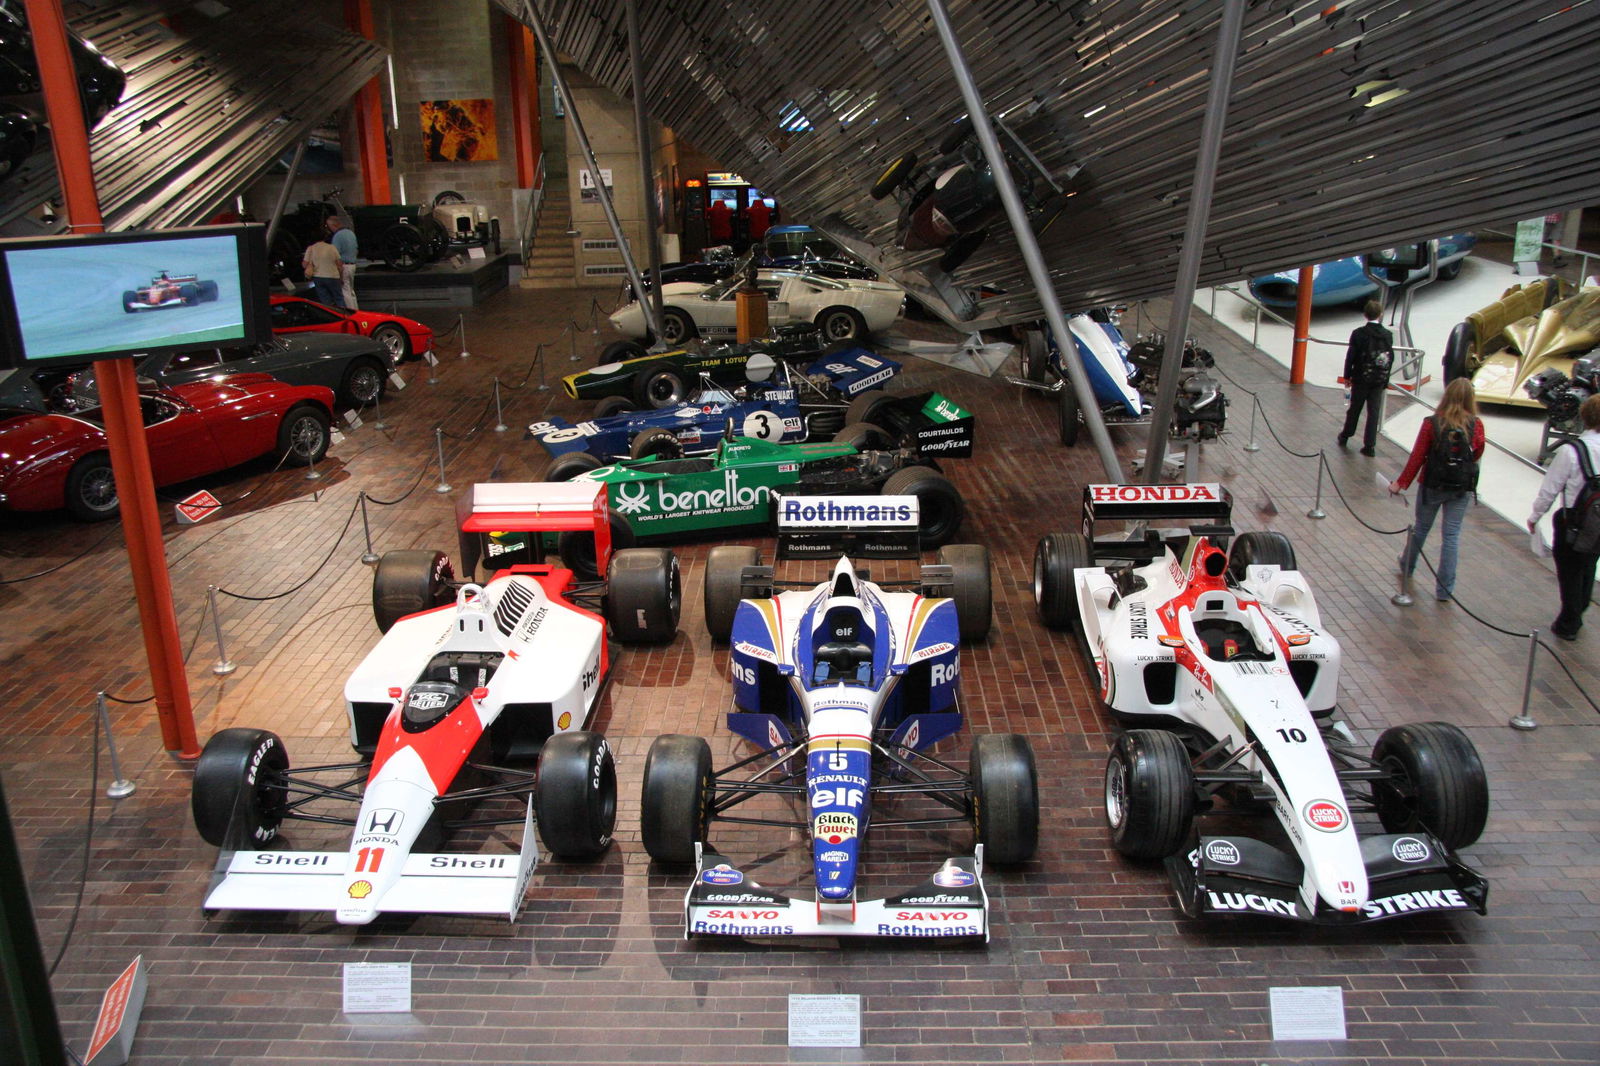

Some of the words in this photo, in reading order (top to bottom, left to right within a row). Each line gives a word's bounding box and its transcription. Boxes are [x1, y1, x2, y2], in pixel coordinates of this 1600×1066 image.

[701, 359, 721, 367] TEAM
[725, 355, 748, 365] LOTUS
[825, 363, 858, 374] elf
[851, 369, 892, 393] GOODYEAR
[764, 389, 795, 401] STEWART
[755, 414, 771, 439] 3
[783, 416, 799, 427] elf
[918, 427, 964, 439] COURTAULDS
[920, 439, 971, 452] GOODYEAR
[1092, 486, 1216, 502] HONDA
[637, 513, 664, 522] WORLD'S
[664, 511, 691, 520] LARGEST
[692, 508, 722, 517] KNITWEAR
[723, 504, 755, 514] PRODUCER
[785, 500, 911, 521] Rothmans
[788, 543, 831, 551] Rothmans
[865, 543, 908, 551] Rothmans
[1168, 557, 1186, 589] HONDA
[1129, 601, 1147, 617] LUCKY
[526, 606, 549, 635] HONDA
[835, 627, 853, 636] elf
[1130, 618, 1149, 640] STRIKE
[813, 698, 870, 710] Rothmans
[1276, 728, 1308, 743] 10
[247, 743, 268, 786] EAGLE
[828, 753, 848, 771] 5
[808, 774, 868, 788] RENAULT
[811, 787, 864, 809] elf
[1311, 808, 1340, 816] LUCKY
[818, 814, 855, 826] Black
[1312, 815, 1342, 823] STRIKE
[816, 824, 856, 836] Tower
[354, 836, 400, 847] HONDA
[1396, 842, 1423, 853] LUCKY
[1210, 845, 1235, 855] LUCKY
[1399, 850, 1426, 860] STRIKE
[255, 853, 329, 867] Shell
[354, 847, 386, 873] 11
[429, 856, 506, 869] Shell
[1211, 853, 1237, 863] STRIKE
[706, 893, 775, 903] GOODYEAR
[901, 894, 970, 904] GOODYEAR
[1361, 889, 1469, 919] STRIKE
[1208, 892, 1300, 918] LUCKY
[706, 909, 780, 920] SANYO
[895, 911, 969, 921] SANYO
[694, 920, 794, 936] Rothmans
[877, 923, 979, 937] Rothmans
